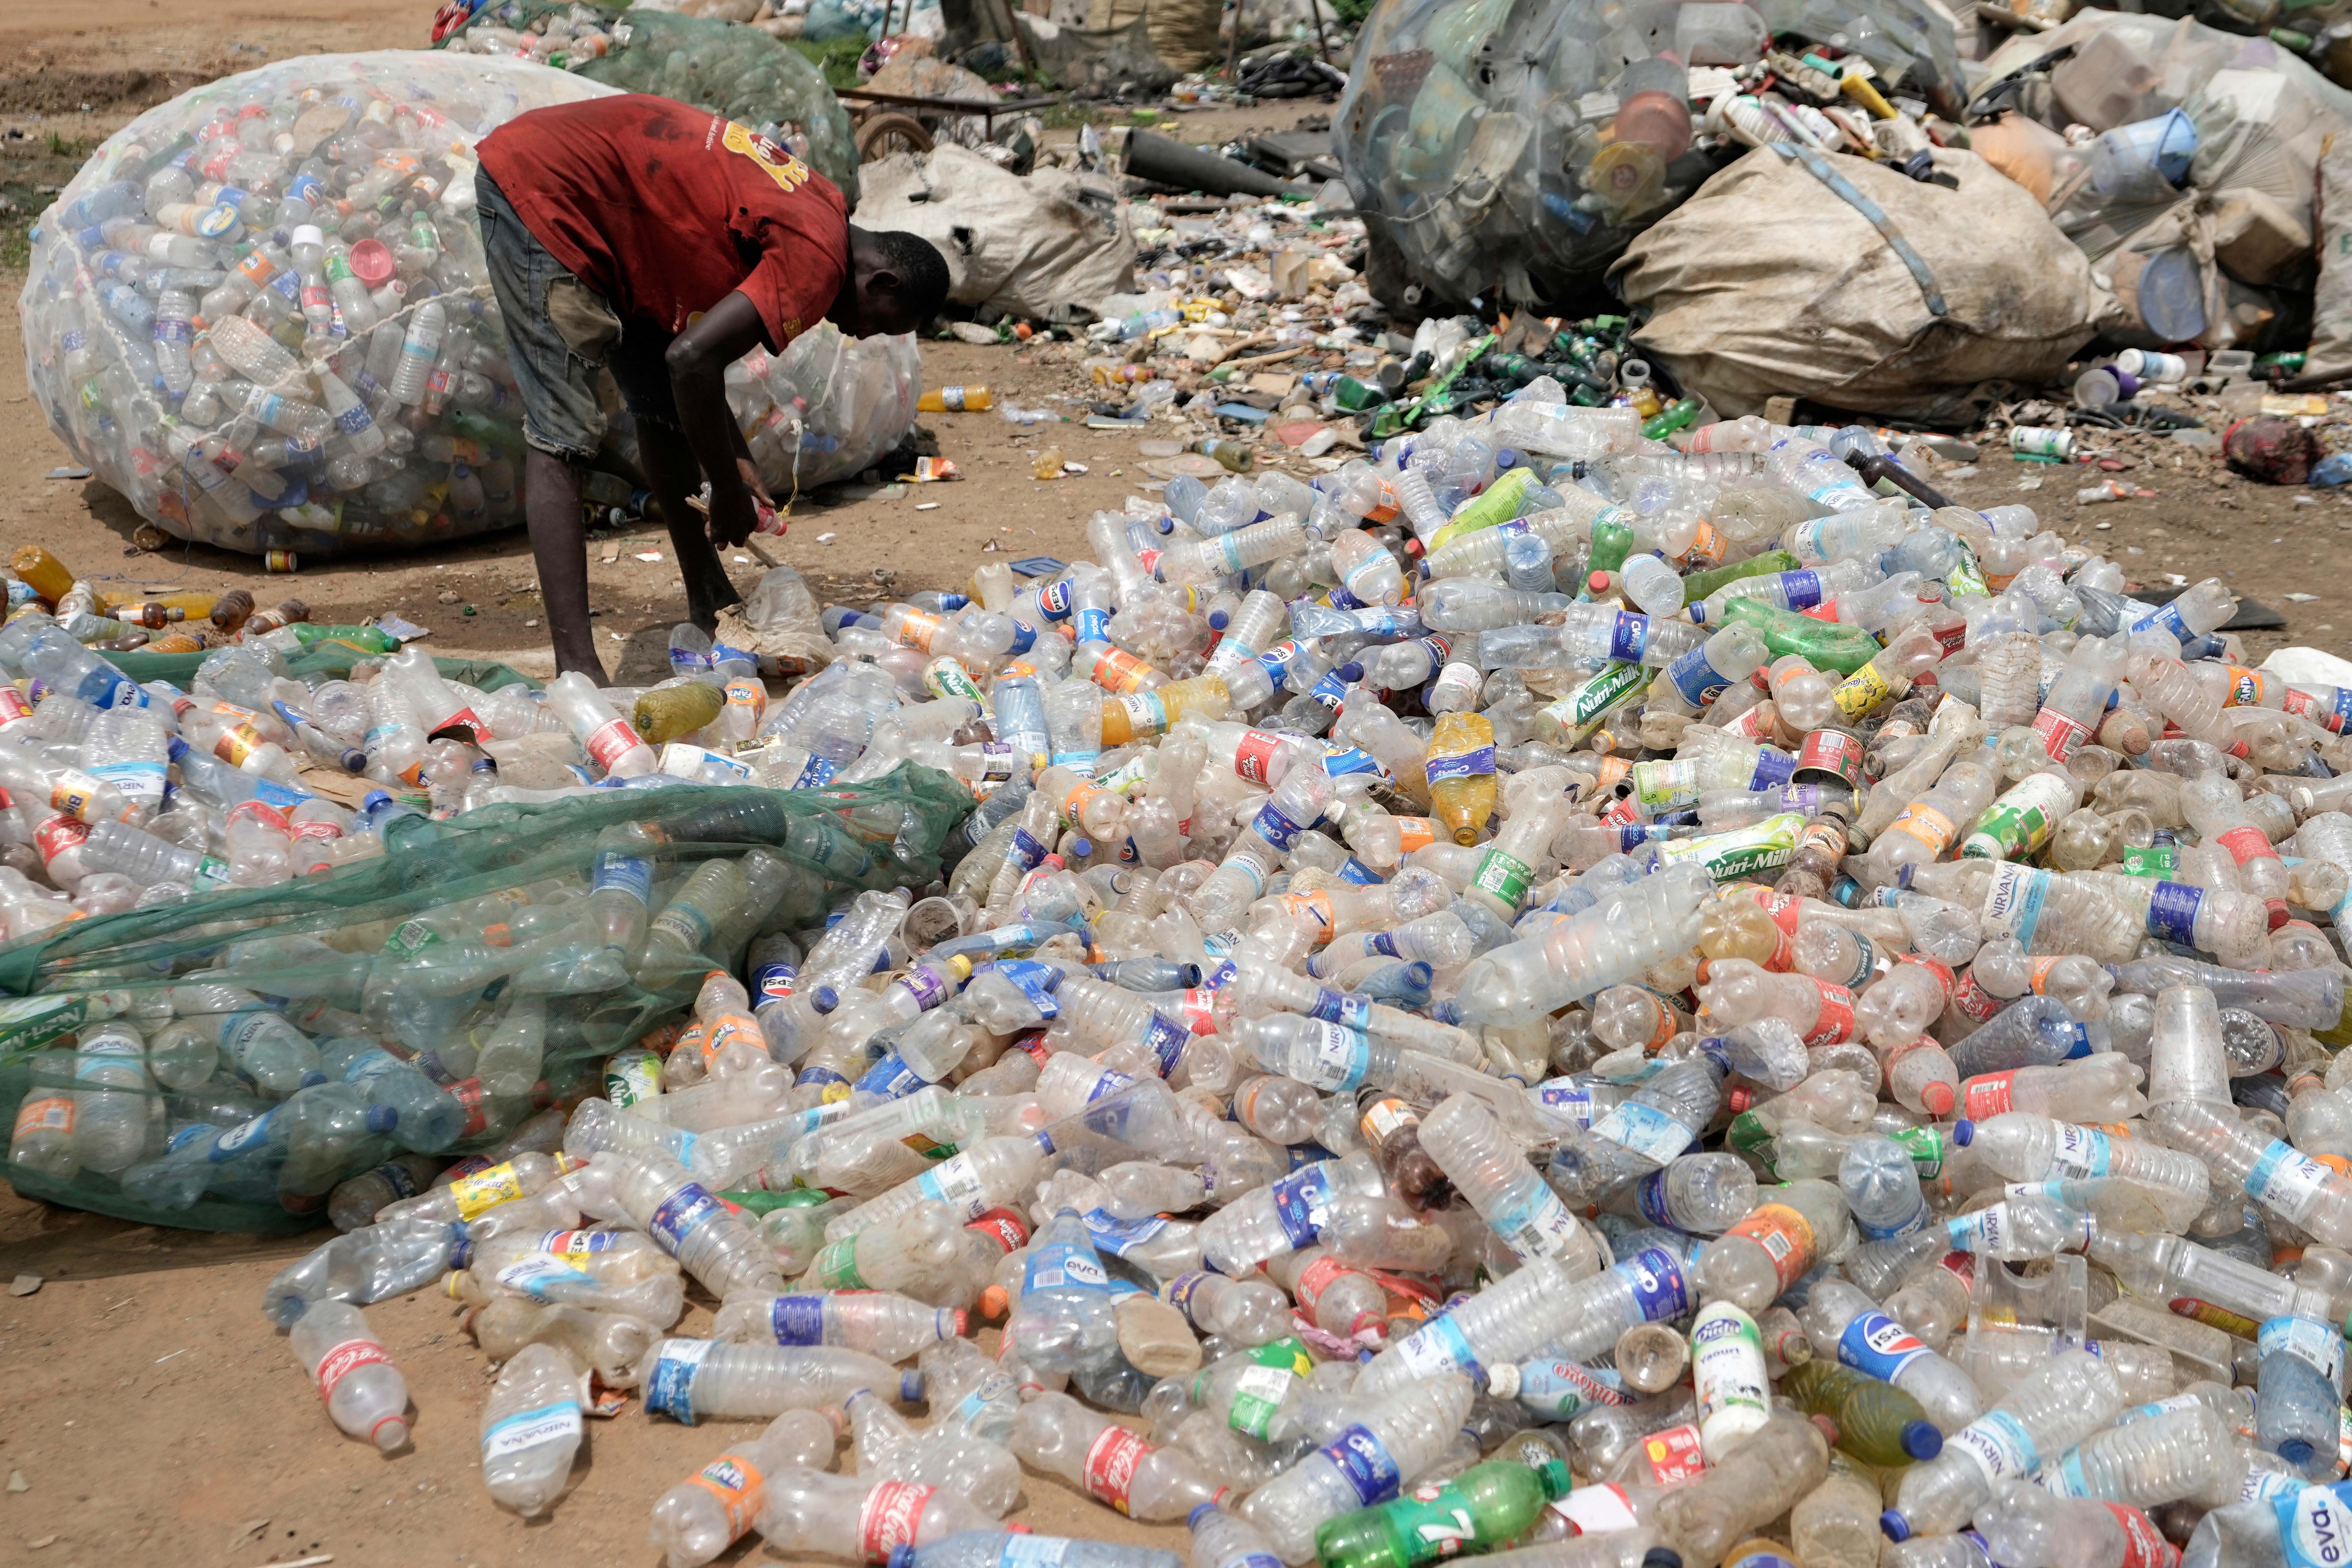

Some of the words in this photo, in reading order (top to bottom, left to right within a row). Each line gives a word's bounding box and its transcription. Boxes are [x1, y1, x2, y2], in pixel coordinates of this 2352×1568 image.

[1089, 614, 1101, 636] pepsi
[1631, 621, 1641, 653] CWAY
[1579, 664, 1641, 718] Nutri-Milk
[1840, 677, 1860, 688] Casera
[2236, 676, 2250, 704] FANTA
[1433, 765, 1468, 779] CWAY
[116, 781, 145, 791] NIRV
[1256, 815, 1283, 840] CWAY
[1708, 847, 1791, 880] Nutri-Mil
[1991, 864, 2016, 920] NIRVANA
[2025, 885, 2034, 910] premium
[676, 1029, 701, 1043] FANT
[709, 1023, 736, 1051] FANTA
[1328, 1022, 1340, 1054] NIRV
[1066, 1262, 1099, 1278] eva
[1874, 1327, 1903, 1346] PSI
[501, 1421, 572, 1446] NIRVANA
[1955, 1428, 2004, 1476] NIRVAN
[2311, 1509, 2339, 1563] eva
